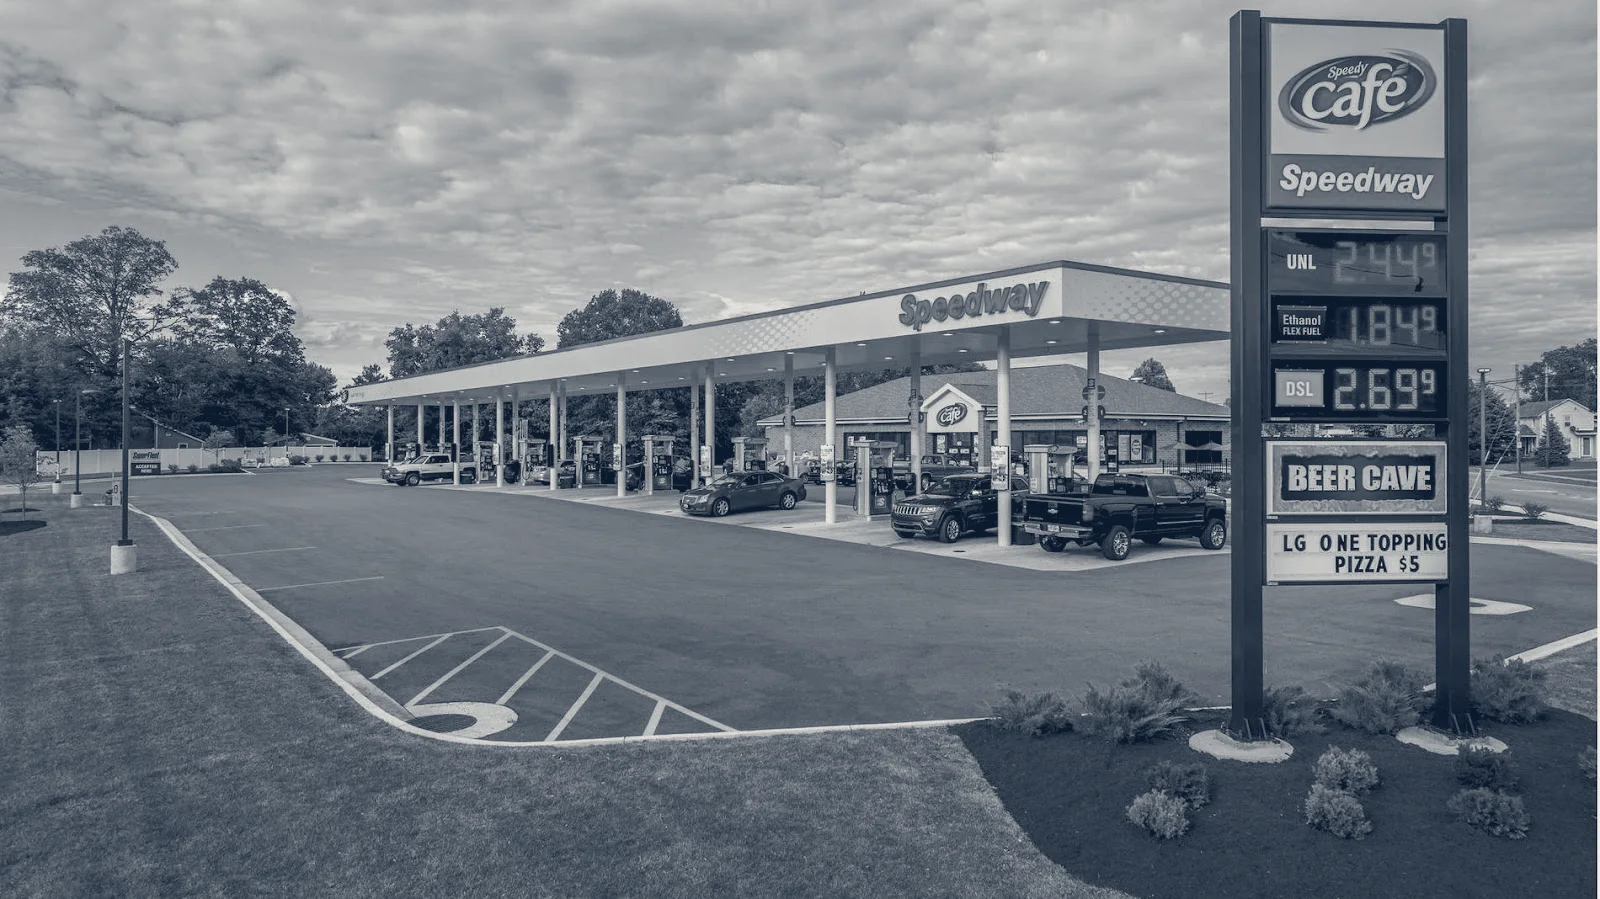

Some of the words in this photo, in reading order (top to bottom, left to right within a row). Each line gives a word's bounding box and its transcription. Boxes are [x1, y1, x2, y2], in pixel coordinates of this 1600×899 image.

[1327, 61, 1369, 79] Speedy
[1279, 164, 1434, 200] Speedway
[1286, 253, 1317, 270] UNL
[899, 281, 1050, 331] Speedway
[1282, 314, 1321, 326] Ethanol
[1282, 327, 1301, 336] FLEX
[1302, 327, 1321, 336] FUEL
[1285, 380, 1314, 397] DSL
[1288, 465, 1356, 491] BEER
[1362, 465, 1432, 491] CAVE
[1283, 534, 1306, 552] LG
[1367, 533, 1447, 552] TOPPING
[1335, 556, 1388, 573] PIZZA
[1399, 555, 1420, 573] $5
